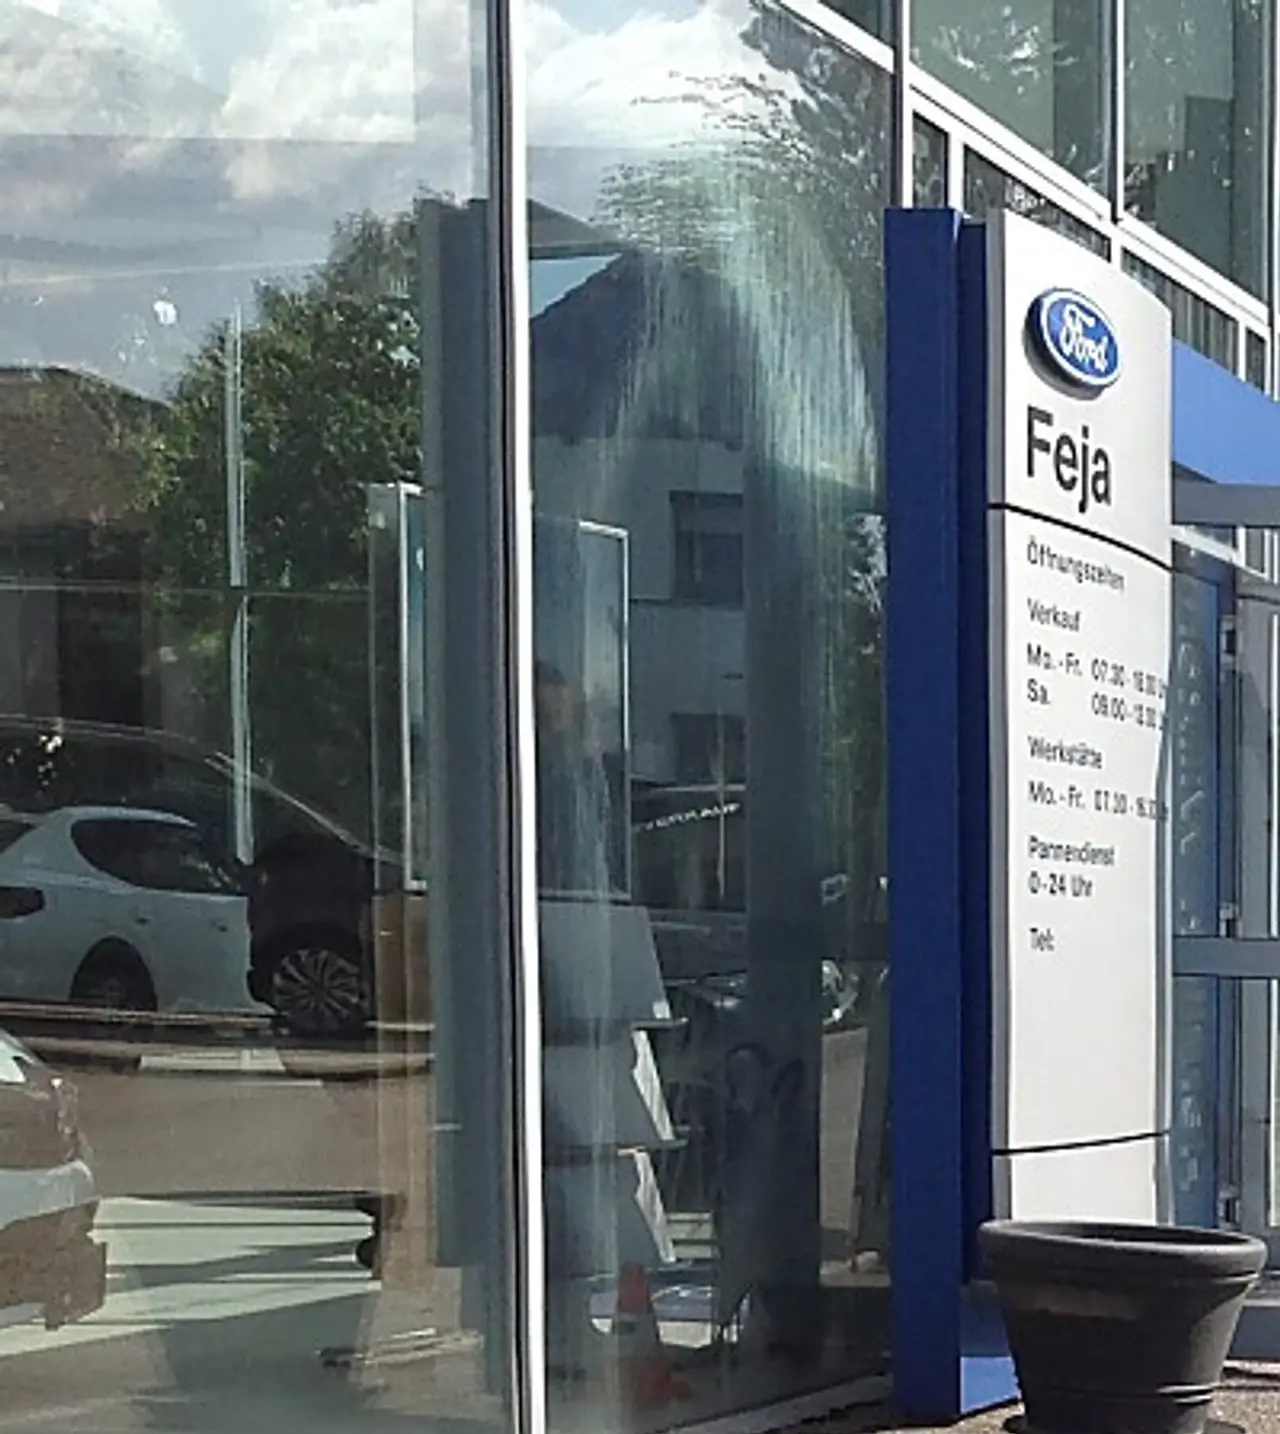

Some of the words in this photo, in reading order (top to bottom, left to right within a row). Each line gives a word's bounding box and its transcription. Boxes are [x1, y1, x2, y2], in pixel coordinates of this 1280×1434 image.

[1027, 404, 1112, 514] Feja
[1027, 535, 1125, 593] Öffnungszeiten
[1027, 597, 1081, 632] Verkauf
[1027, 678, 1050, 705] Sa.
